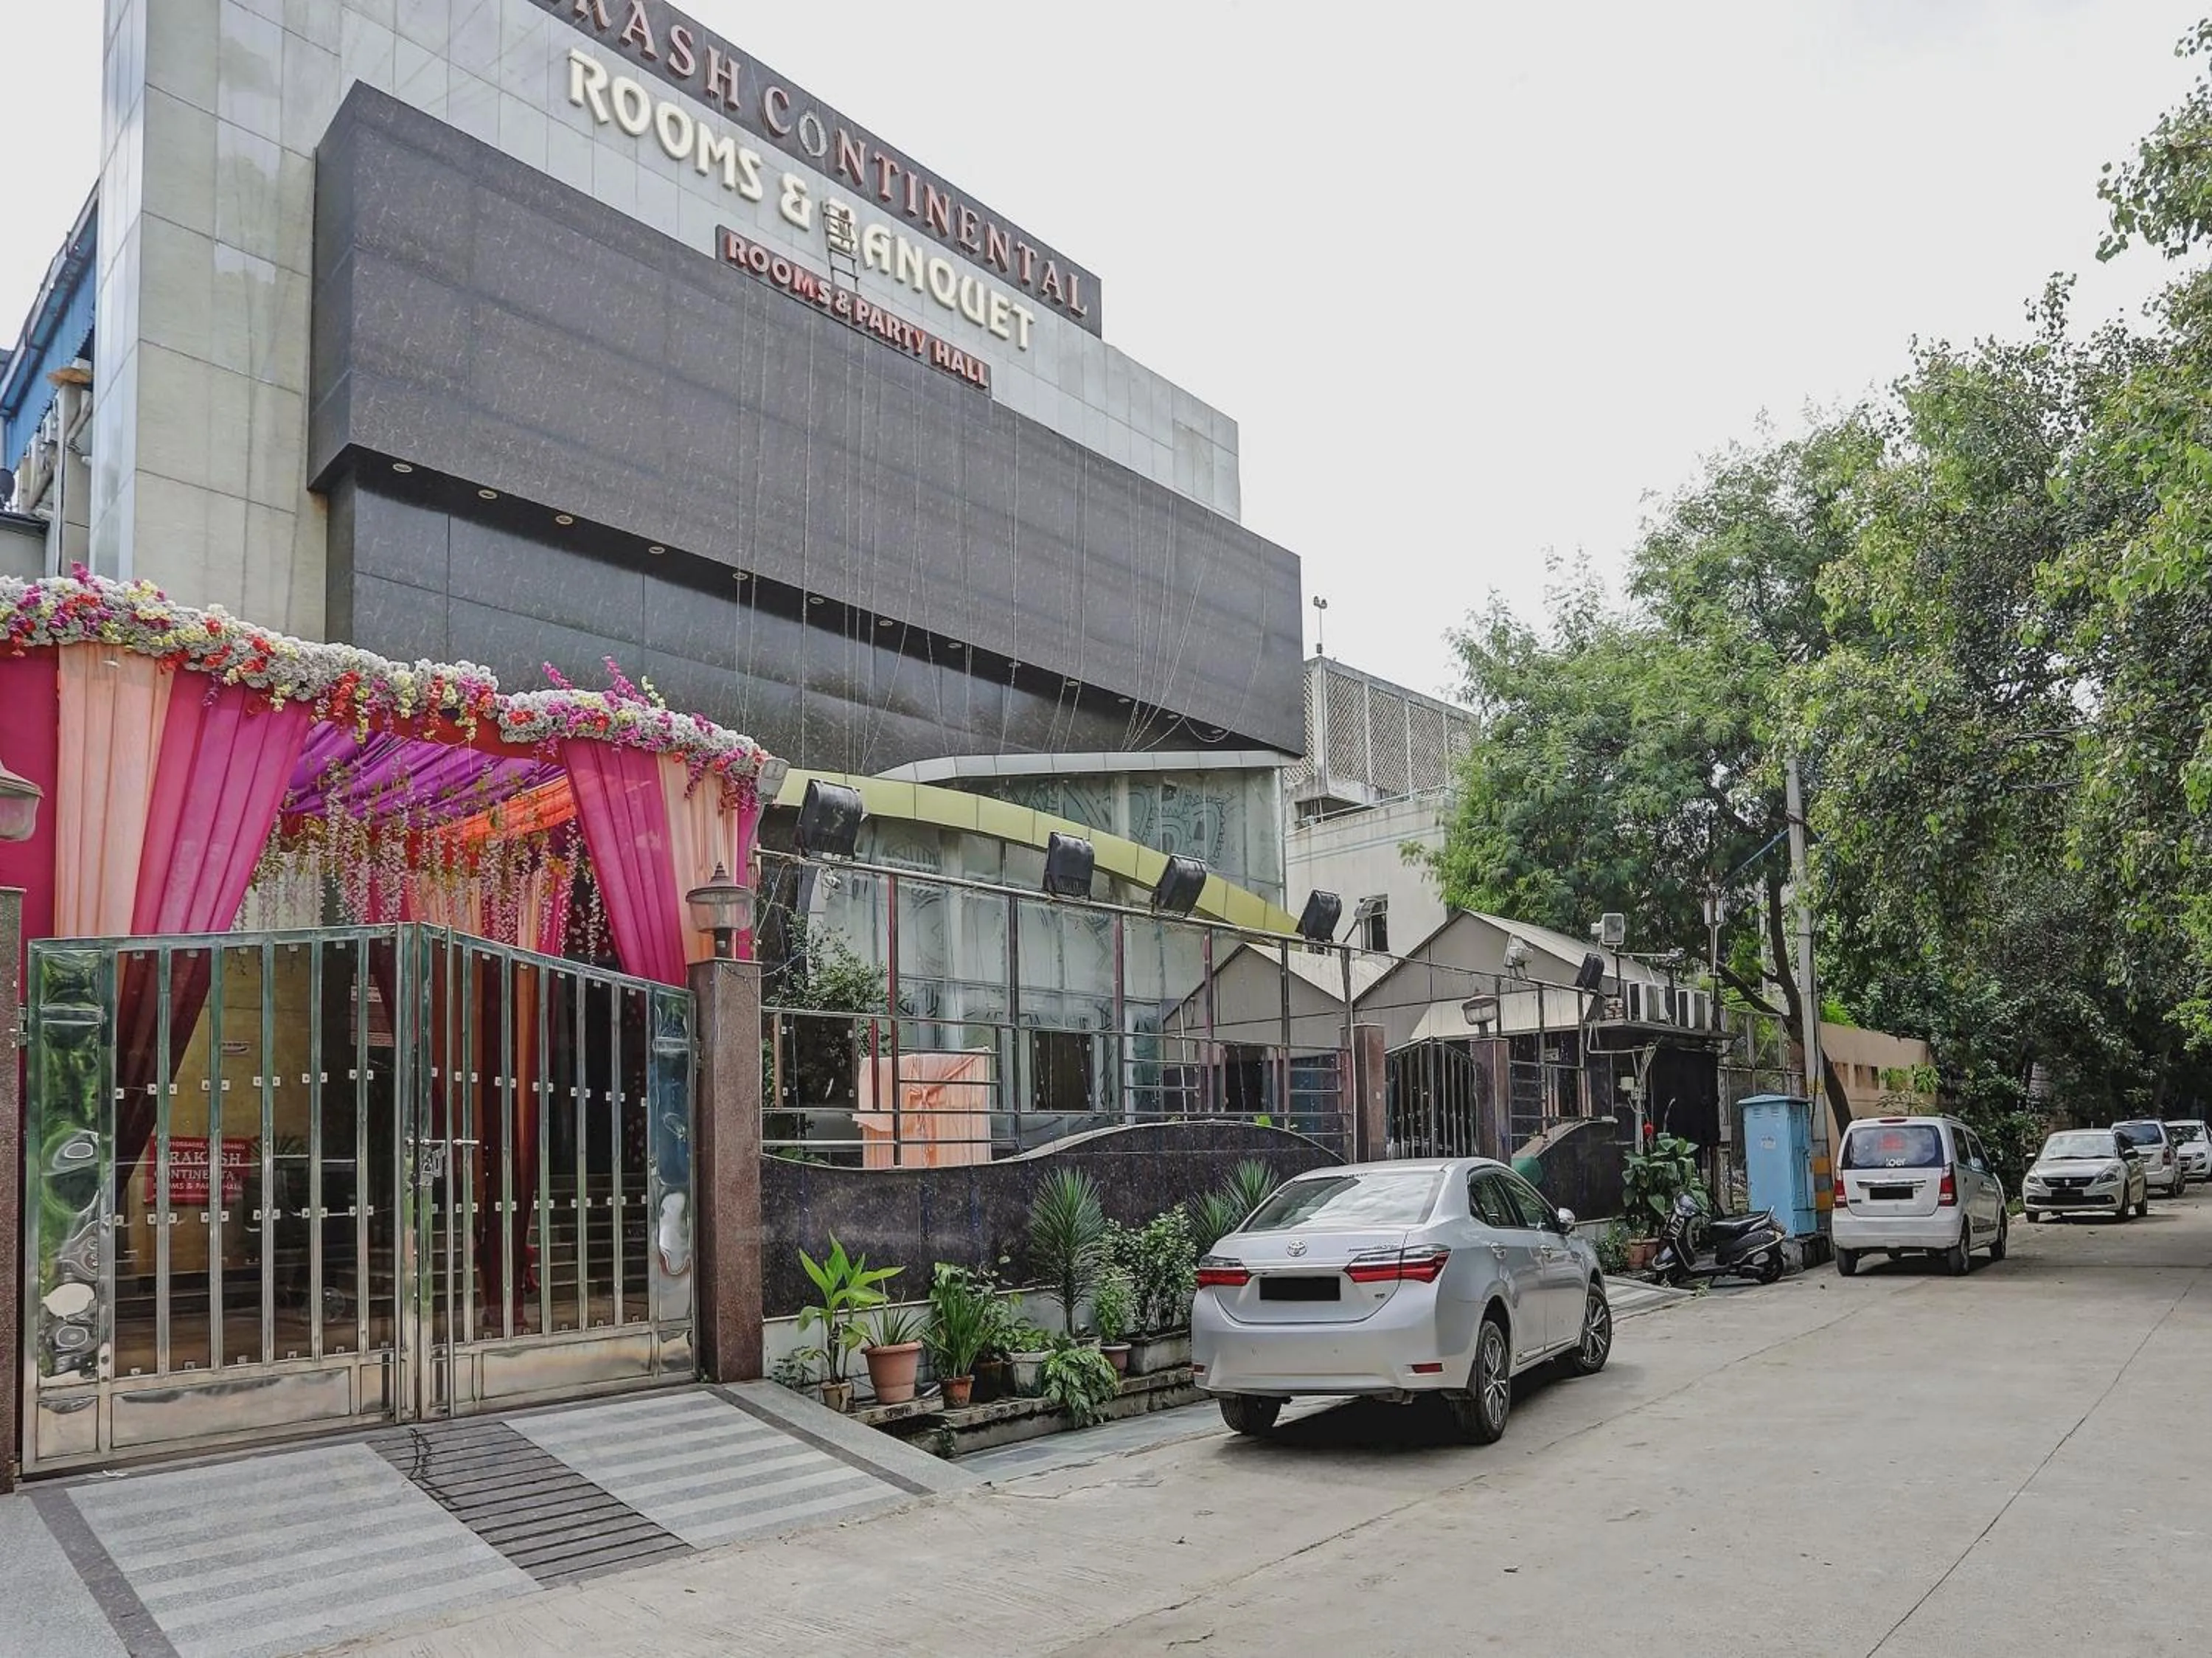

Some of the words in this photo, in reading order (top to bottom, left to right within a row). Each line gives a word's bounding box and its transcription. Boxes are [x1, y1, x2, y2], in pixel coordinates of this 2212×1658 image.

[567, 47, 763, 201] ROOMS
[780, 172, 812, 232] &
[823, 197, 1035, 352] BANQUET
[762, 86, 1088, 318] CONTINENTAL
[725, 232, 832, 308] ROOMS
[832, 288, 852, 316] &
[852, 297, 926, 355] PARTY
[930, 340, 989, 389] HALL
[169, 1151, 241, 1165] RAKSH
